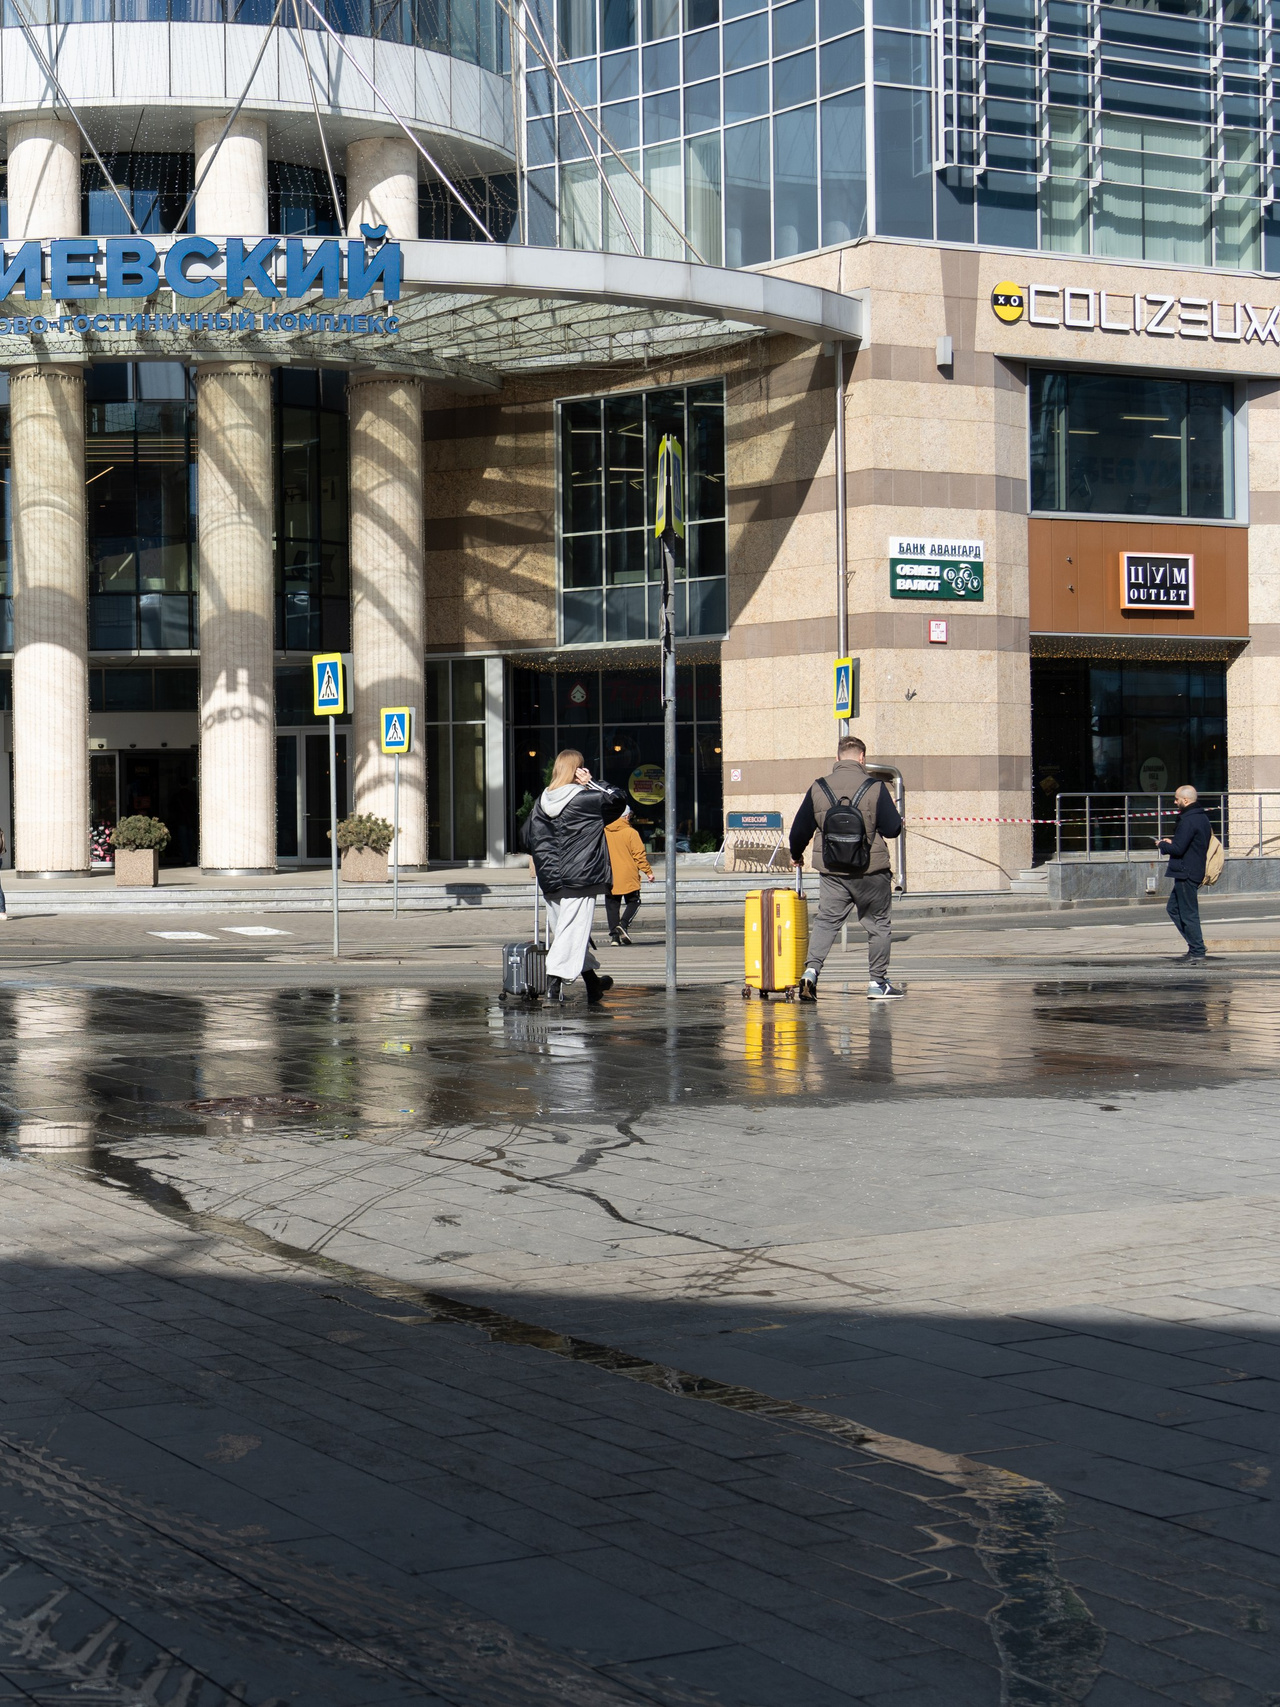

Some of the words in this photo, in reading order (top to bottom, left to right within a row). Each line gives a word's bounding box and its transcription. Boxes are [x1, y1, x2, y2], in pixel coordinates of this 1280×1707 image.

[263, 313, 400, 335] КОМПЛЕКС
[898, 542, 926, 553] БАНК
[930, 544, 982, 558] АВАНГАРД
[896, 564, 941, 577] ОБМЕН
[896, 578, 941, 592] ВАЛЮТ
[1129, 588, 1187, 601] OUTLET
